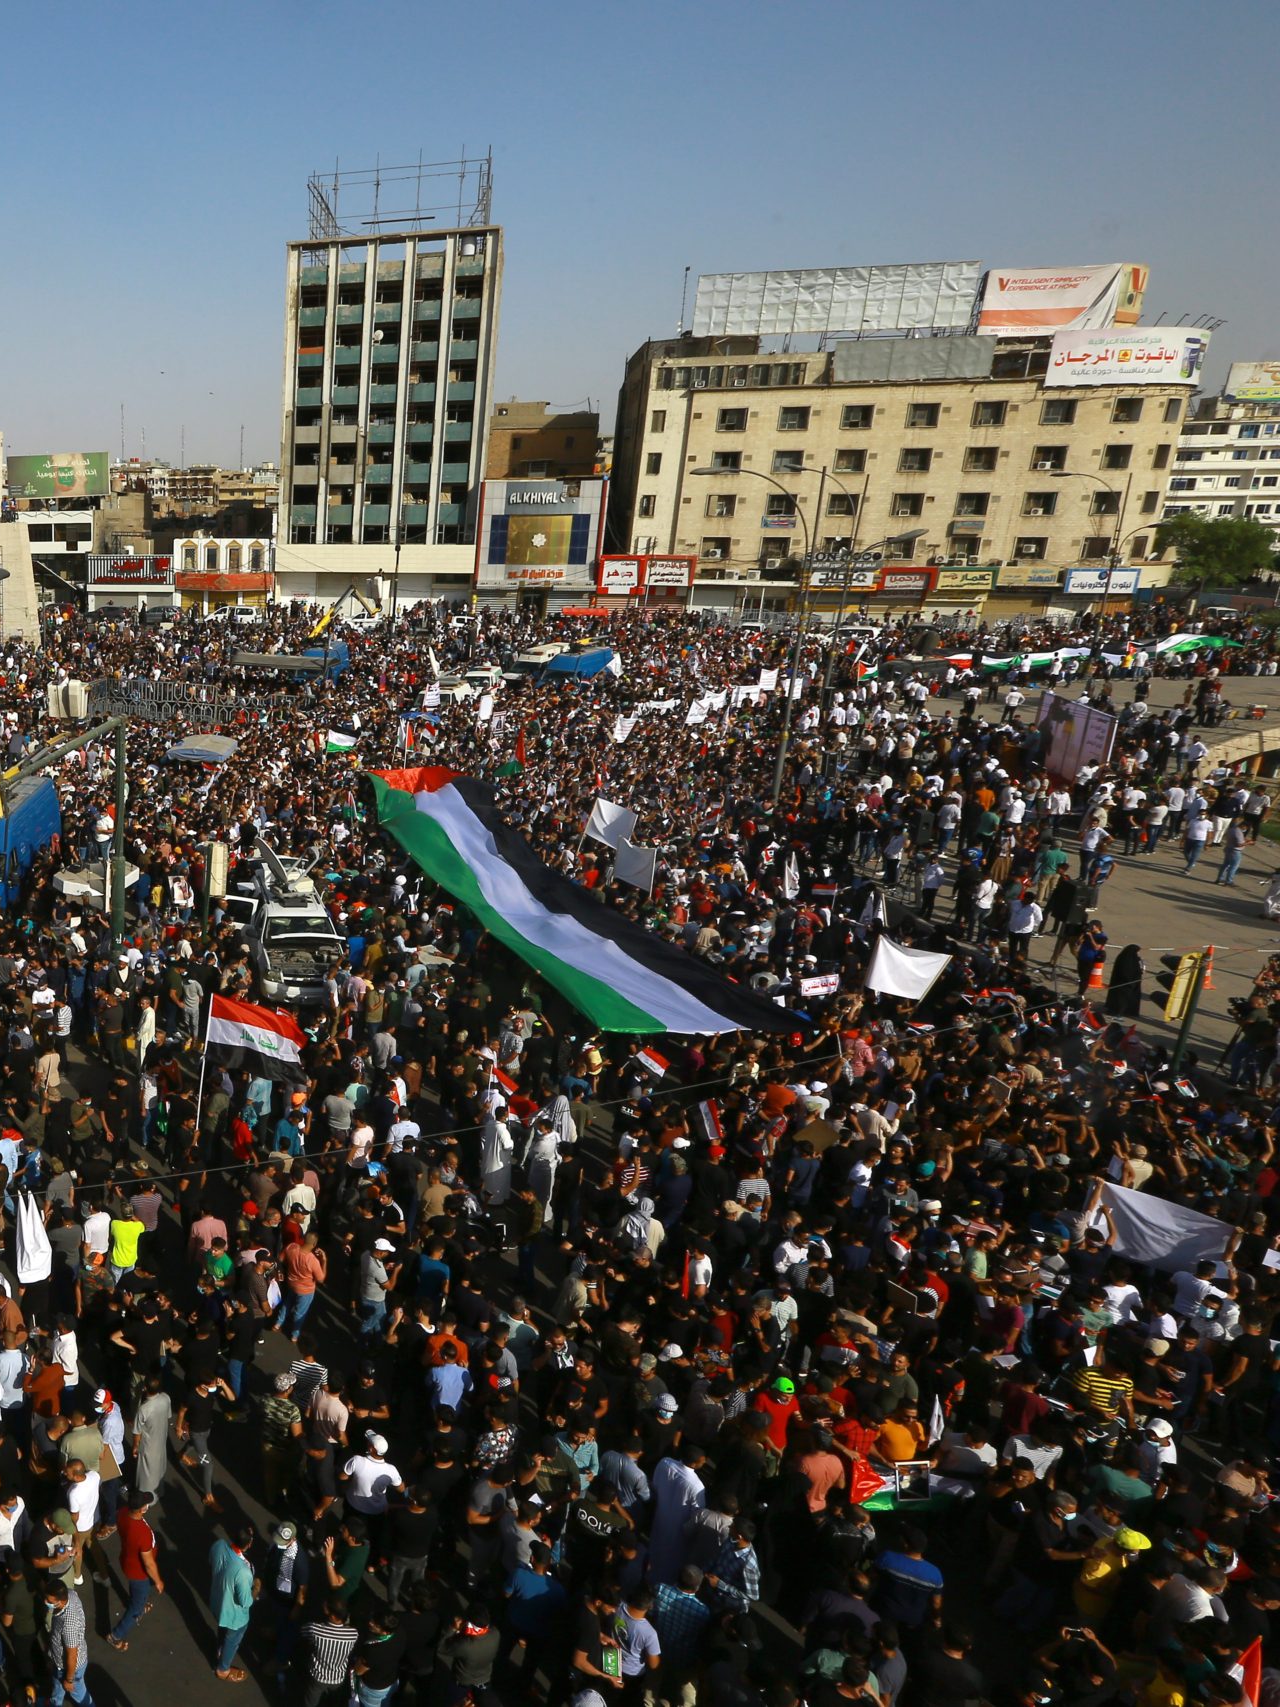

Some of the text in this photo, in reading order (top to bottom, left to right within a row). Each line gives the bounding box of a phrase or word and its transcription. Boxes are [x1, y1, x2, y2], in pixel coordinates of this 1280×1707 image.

[1057, 275, 1092, 283] SIMPLICITY
[1007, 284, 1048, 292] EXPERIENCE
[1054, 346, 1179, 366] الياقوت المرجان
